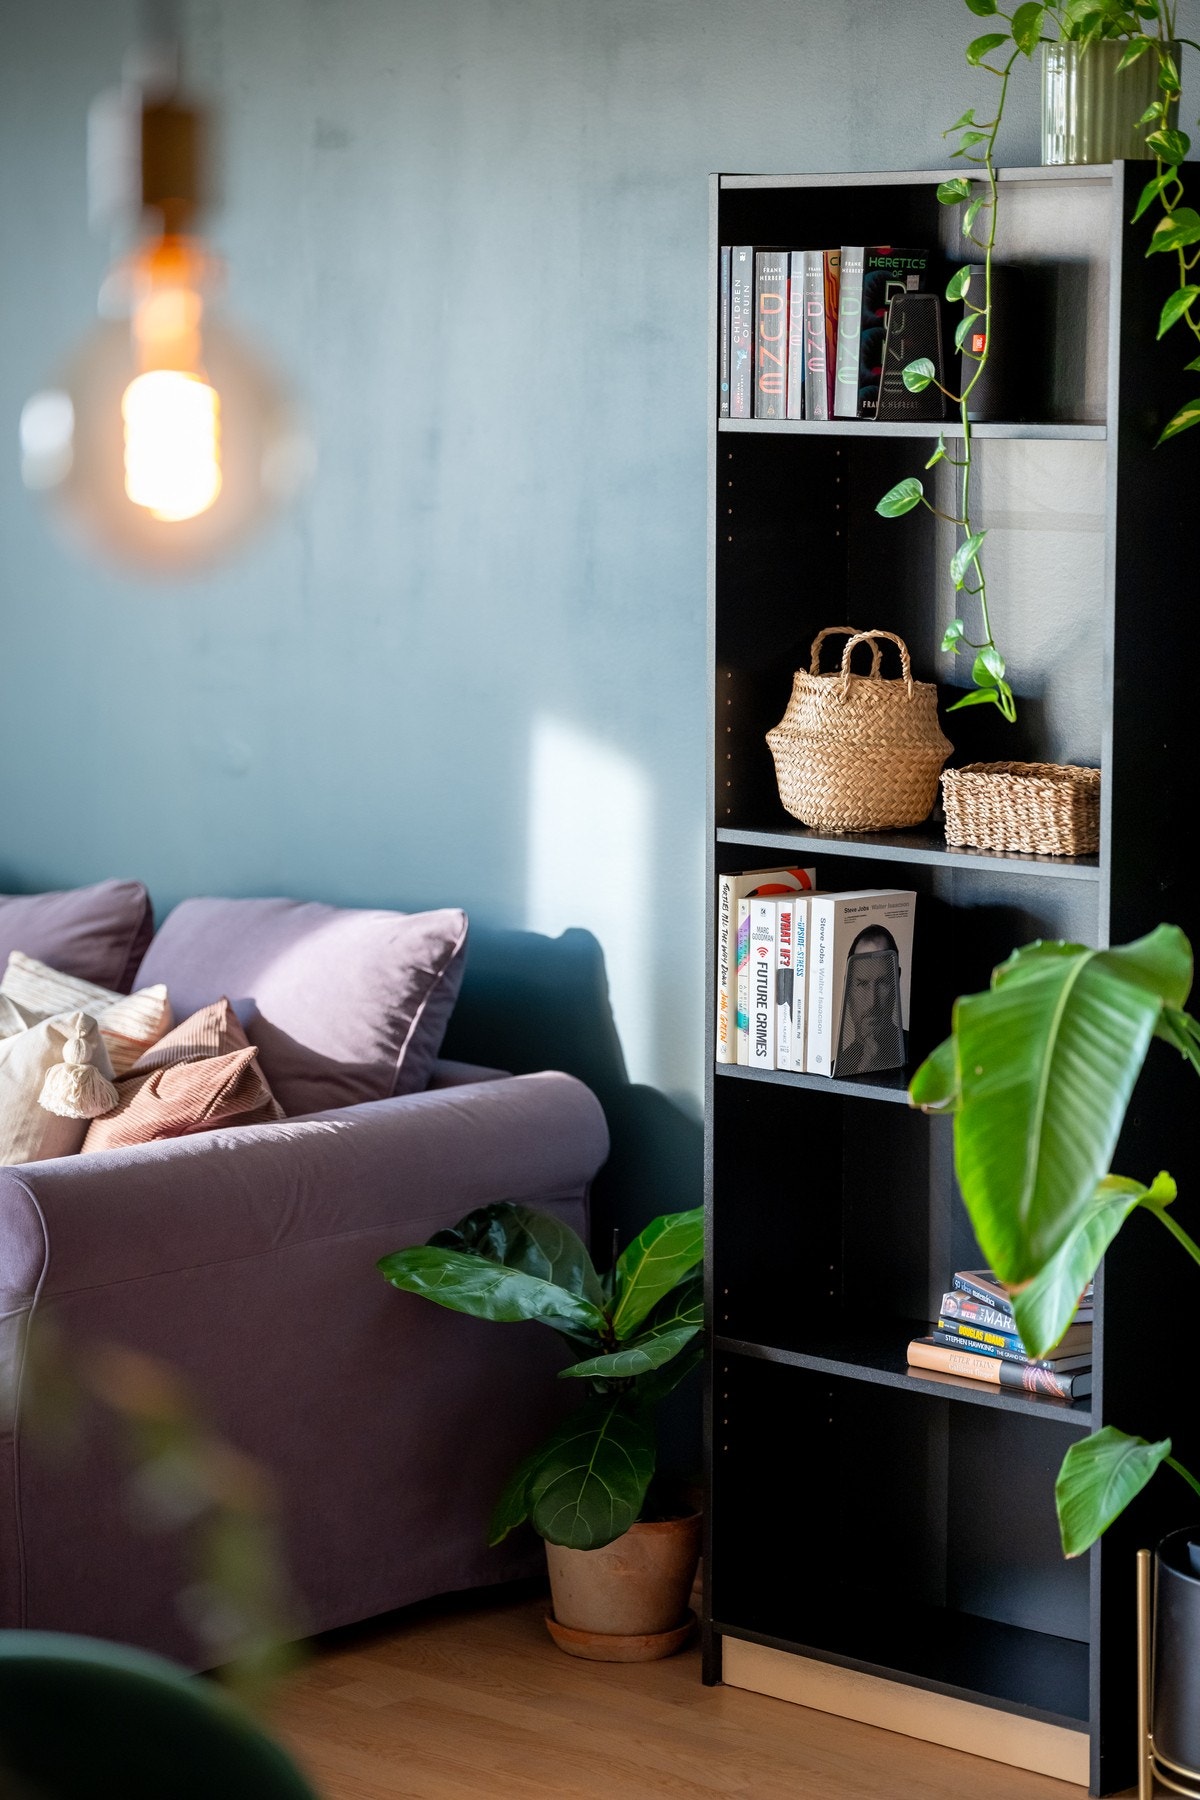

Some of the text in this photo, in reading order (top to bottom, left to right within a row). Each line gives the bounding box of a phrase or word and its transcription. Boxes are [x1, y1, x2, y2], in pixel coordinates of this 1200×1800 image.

[868, 256, 927, 269] HERETICS
[891, 269, 903, 278] OF
[733, 279, 741, 344] CHILDREN
[743, 321, 750, 338] OF
[722, 883, 731, 912] TURTLES
[721, 912, 729, 927] ALL
[819, 917, 827, 941] Steve
[721, 928, 729, 944] THE
[751, 933, 774, 942] GOODMAN
[756, 926, 770, 935] MARC
[780, 912, 791, 967] WHAT IF?
[797, 922, 805, 947] UPSIDE
[720, 944, 728, 964] WAY
[796, 951, 805, 977] STRESS
[818, 943, 826, 964] Jobs
[719, 989, 729, 1013] JOHN
[755, 961, 768, 1057] FUTURE CRIMES
[817, 996, 825, 1035] Isaacson
[719, 1013, 729, 1043] GREEN
[960, 1310, 977, 1320] WEIR
[945, 1334, 969, 1346] STEPHEN
[968, 1340, 995, 1353] HAWKING
[958, 1325, 984, 1341] DOUGLAS
[984, 1332, 1006, 1348] ADAMS
[949, 1354, 995, 1370] PETER ATKINS
